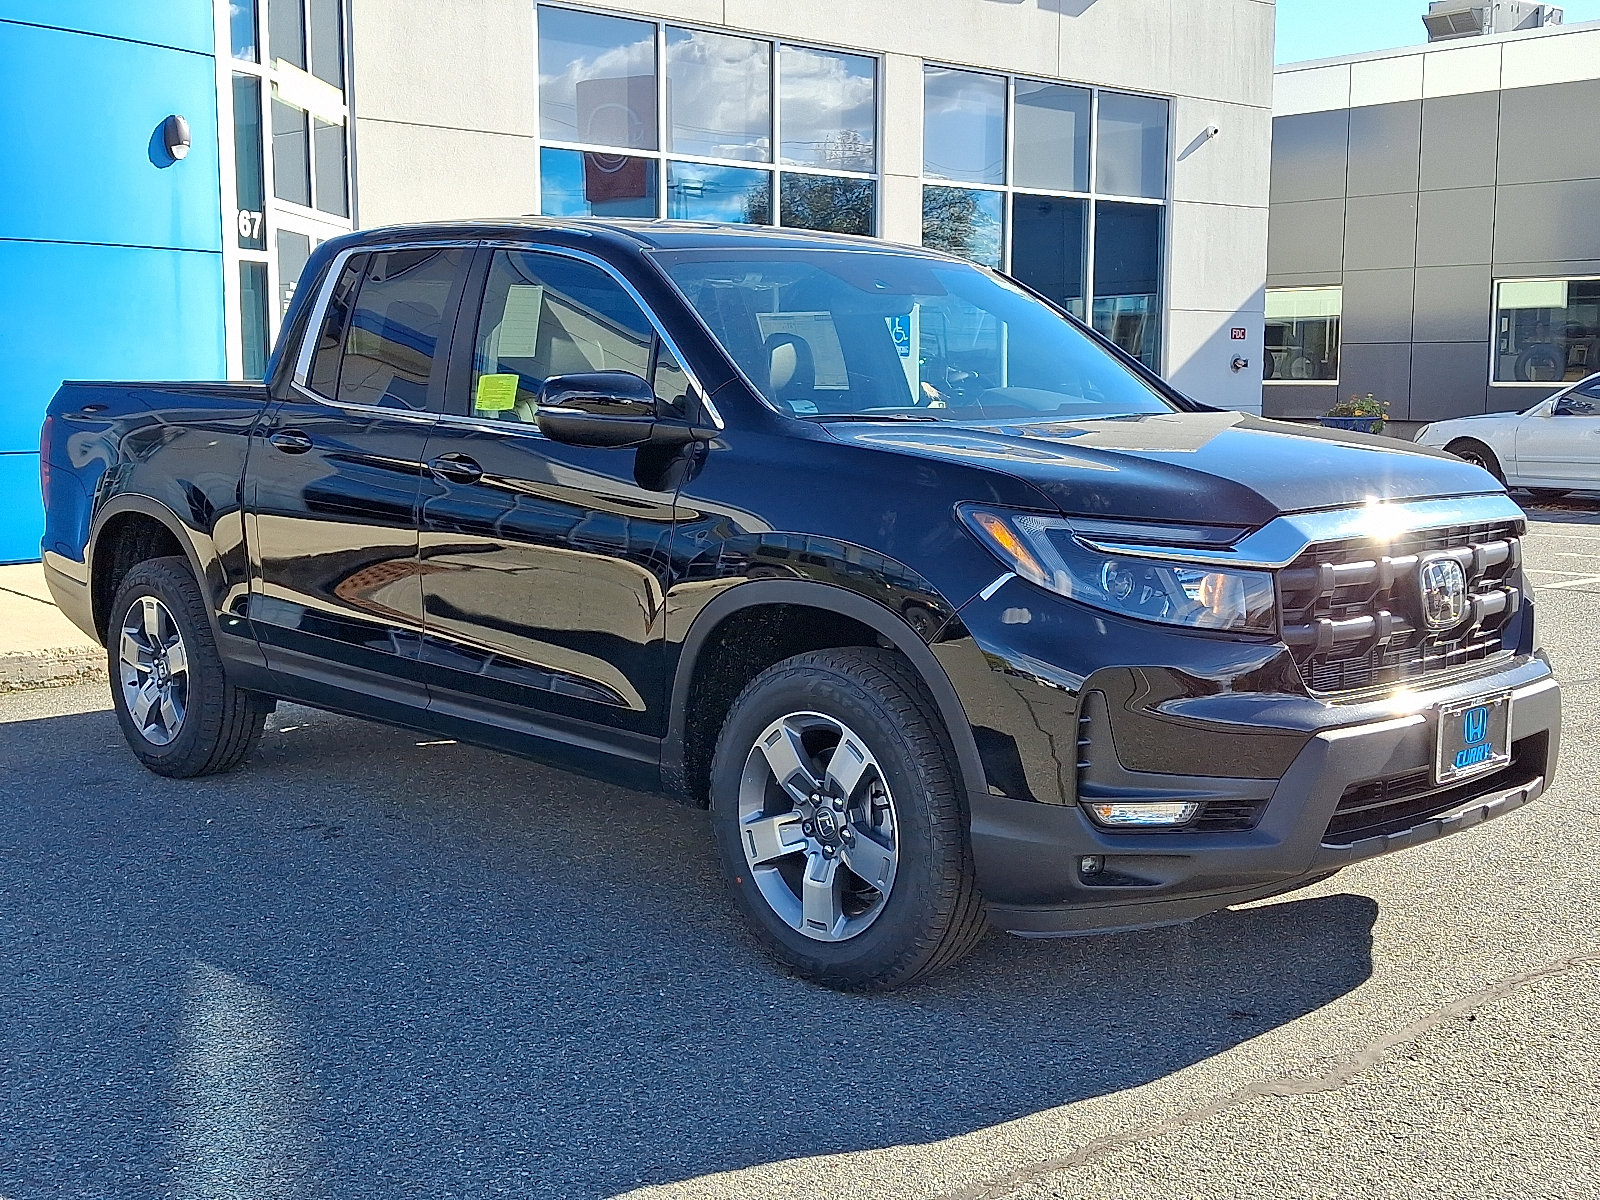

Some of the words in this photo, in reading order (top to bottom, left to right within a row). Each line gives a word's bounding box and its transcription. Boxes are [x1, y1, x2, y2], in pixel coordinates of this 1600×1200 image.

[239, 209, 262, 239] 67
[1232, 329, 1245, 338] FDC
[1456, 743, 1492, 768] CURRY
